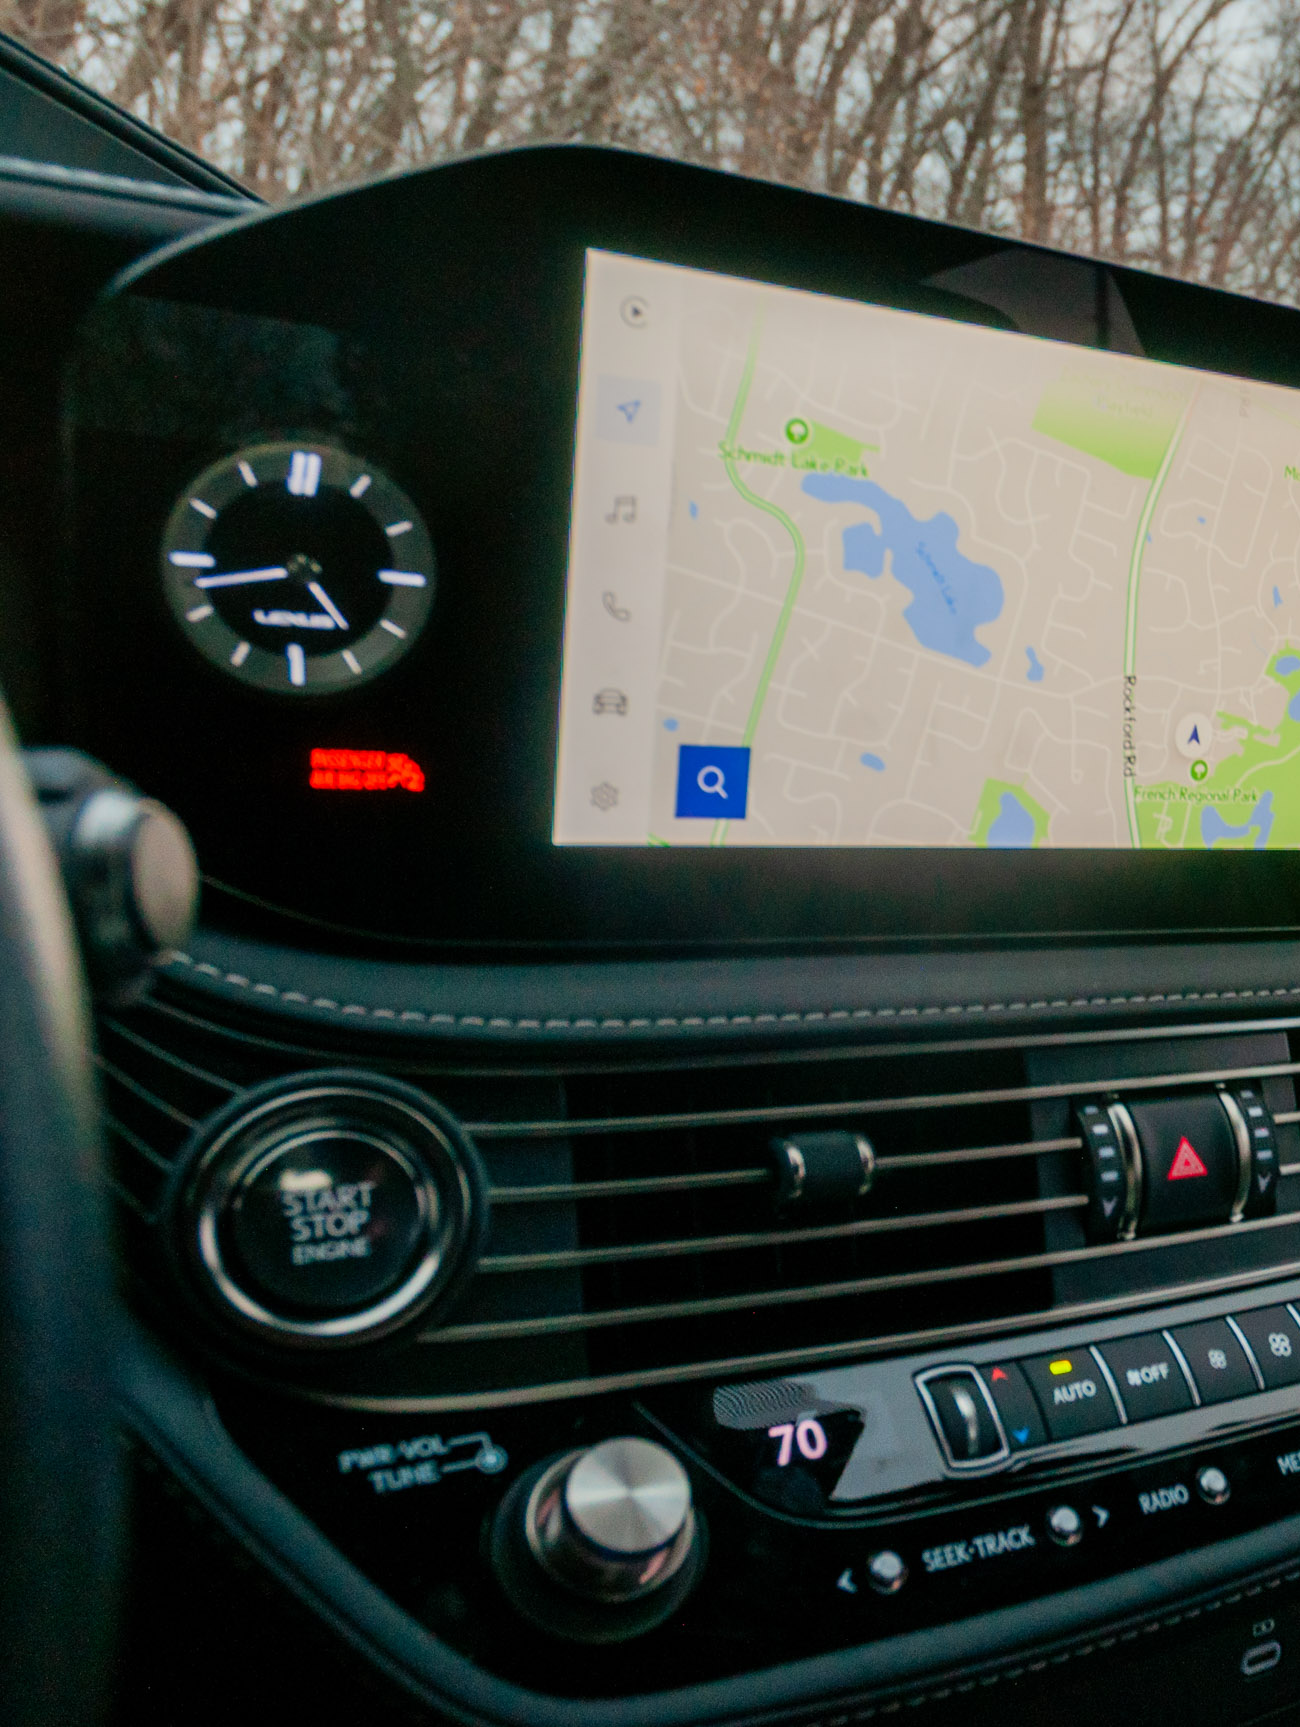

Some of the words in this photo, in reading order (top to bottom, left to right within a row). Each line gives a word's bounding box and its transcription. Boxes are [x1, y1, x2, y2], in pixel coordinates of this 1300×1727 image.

[1122, 675, 1137, 750] Rockford
[1122, 755, 1137, 777] Rd
[1134, 785, 1176, 800] French
[1233, 788, 1257, 802] Park
[281, 1181, 377, 1217] START
[291, 1209, 371, 1243] STOP
[1140, 1362, 1170, 1385] OFF
[1052, 1379, 1098, 1406] AUTO
[767, 1419, 828, 1467] 70
[368, 1459, 441, 1494] TUNE
[1138, 1483, 1190, 1515] RADIO
